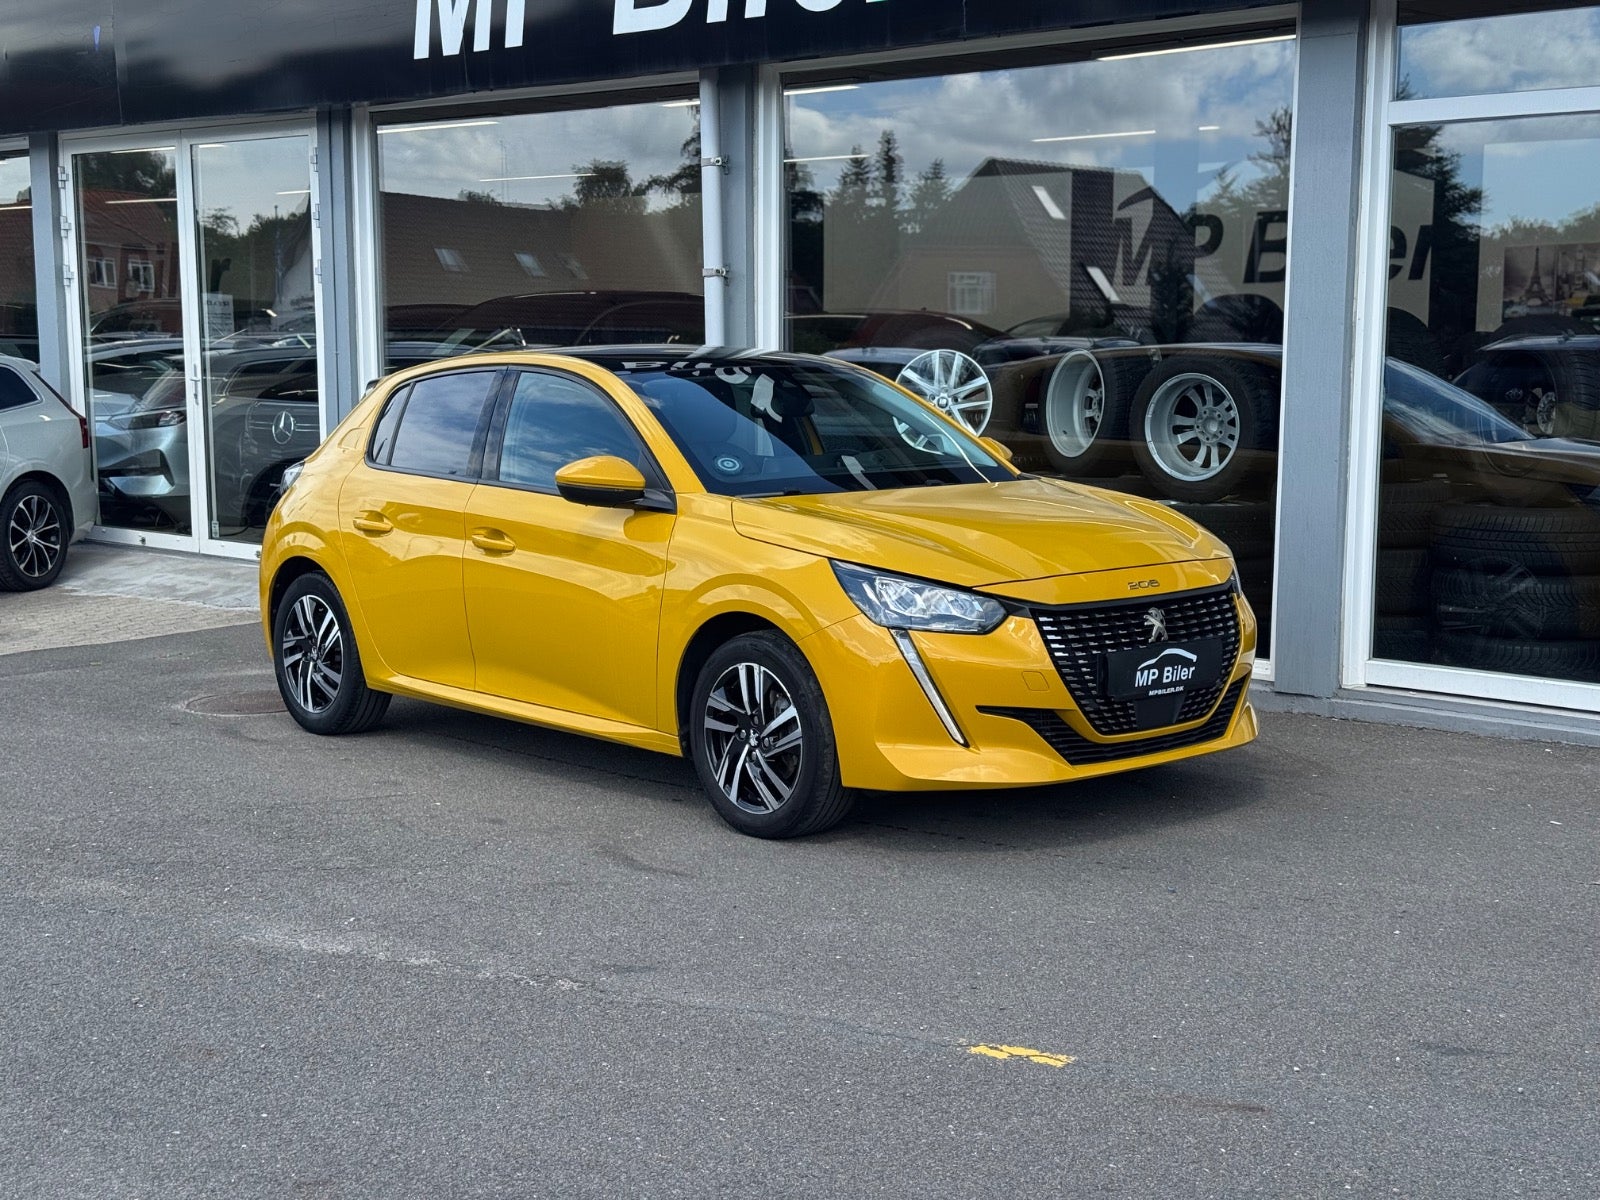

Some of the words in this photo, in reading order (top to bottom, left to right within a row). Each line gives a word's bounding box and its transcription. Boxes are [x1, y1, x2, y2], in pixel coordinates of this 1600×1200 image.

[1128, 580, 1160, 590] 208
[1135, 669, 1158, 687] MP
[1163, 665, 1195, 683] Biler
[1148, 686, 1184, 696] MPBILER.DK
